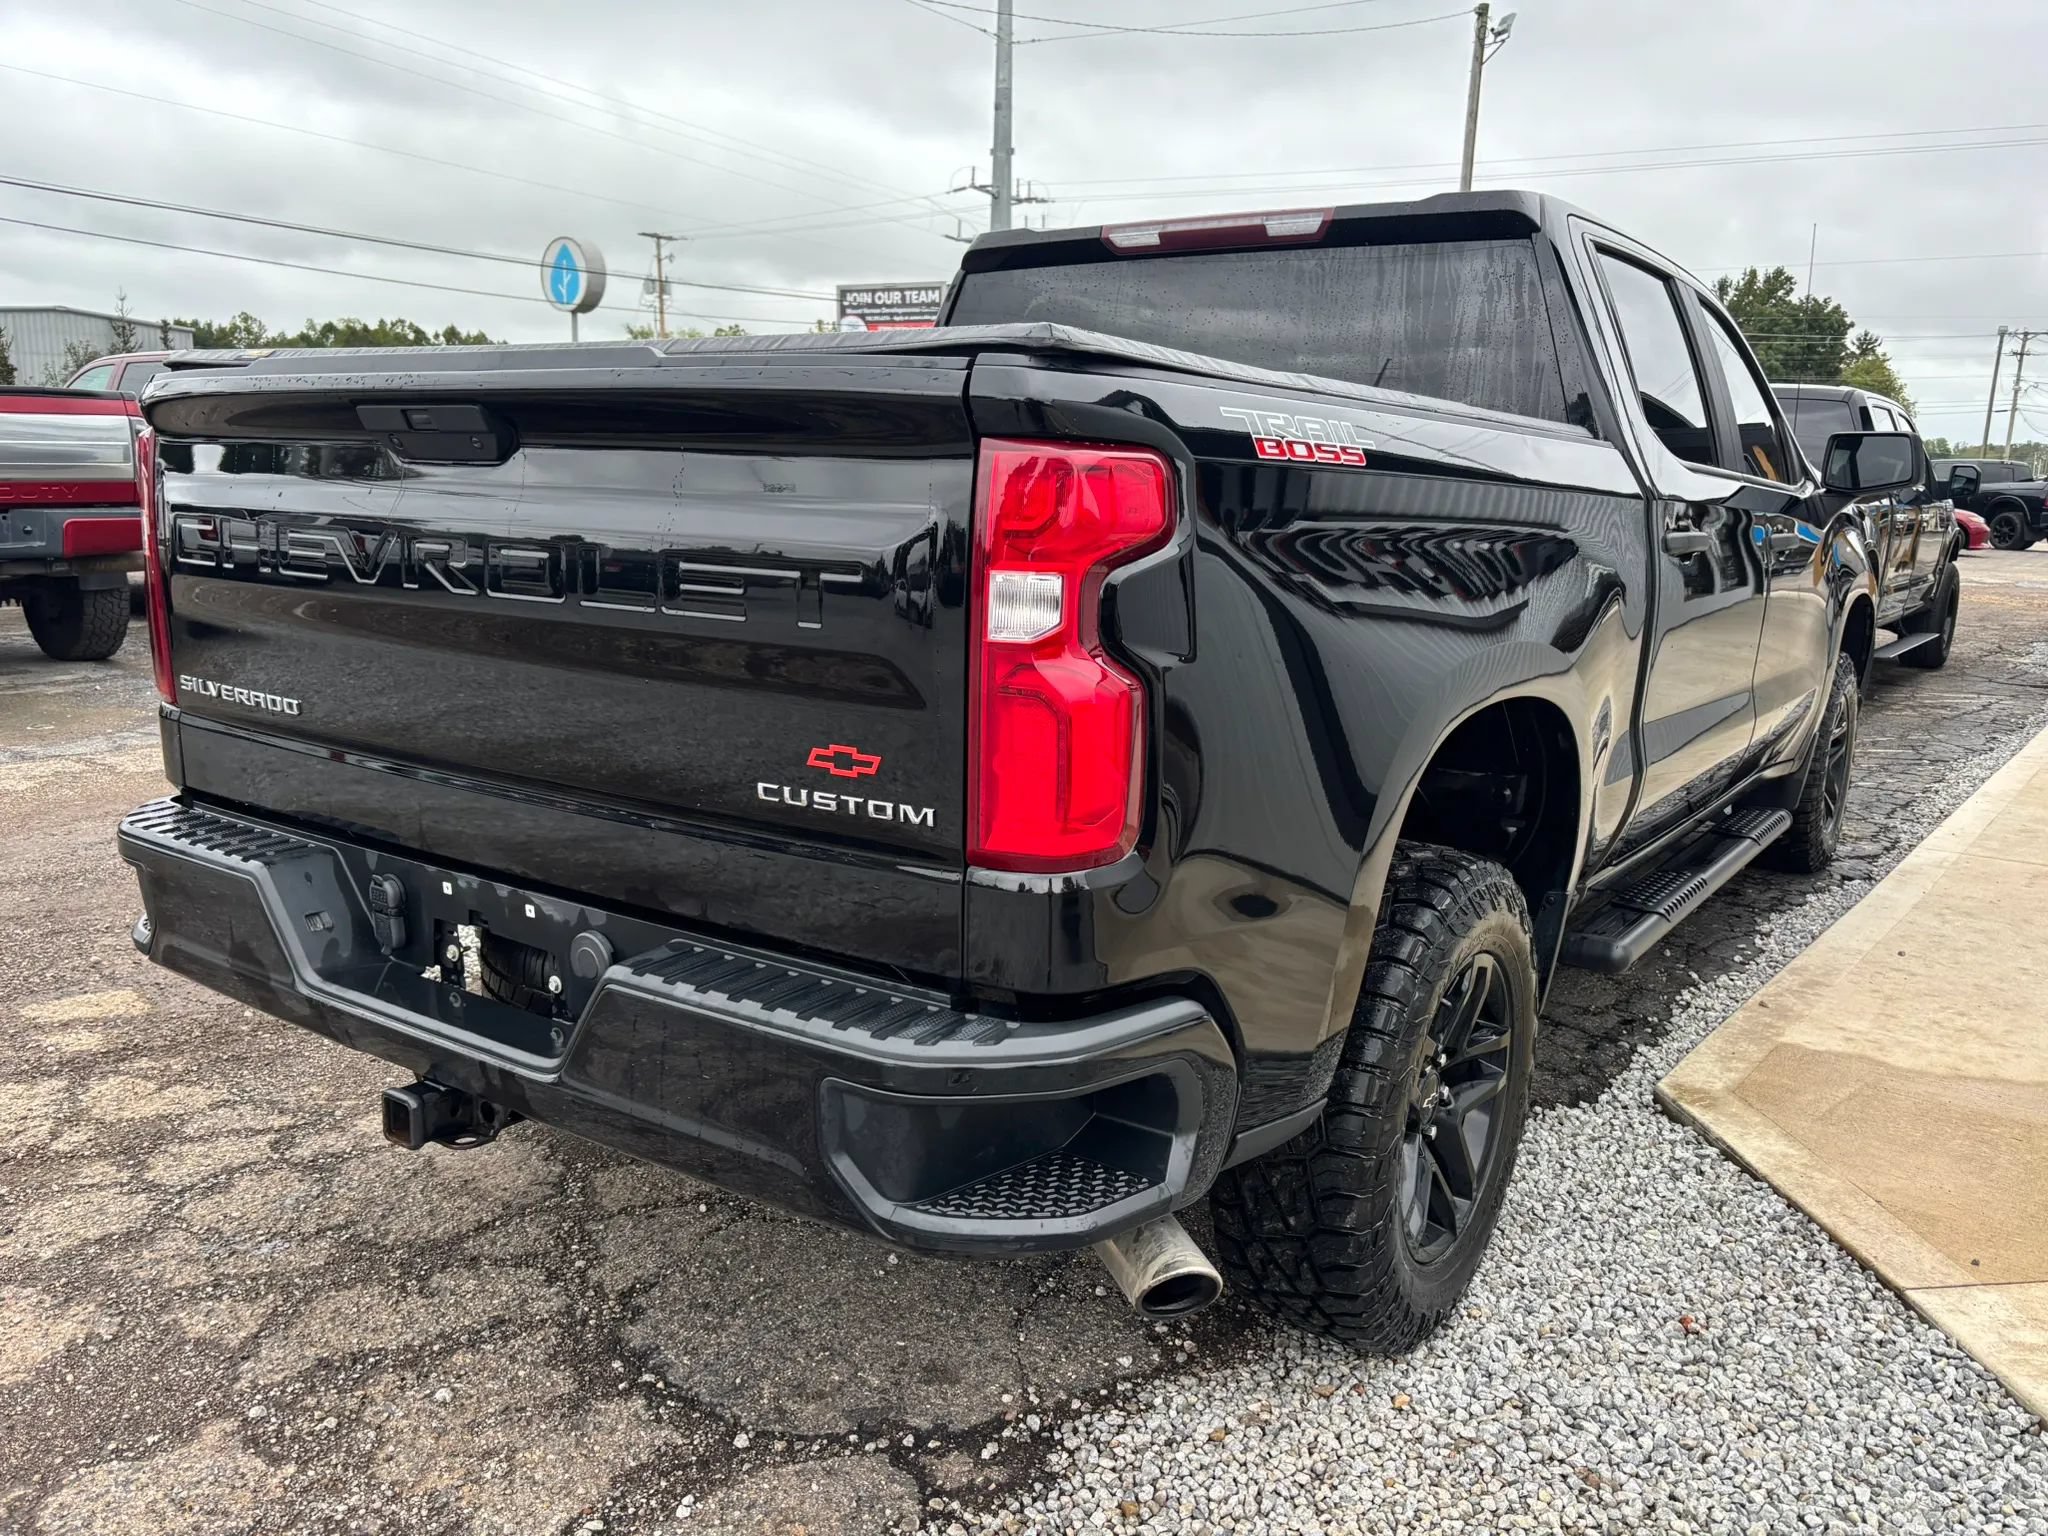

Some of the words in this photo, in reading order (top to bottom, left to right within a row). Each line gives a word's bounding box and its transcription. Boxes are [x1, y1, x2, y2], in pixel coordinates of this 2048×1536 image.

[843, 291, 872, 305] JOIN
[874, 290, 902, 305] OUR
[904, 289, 940, 304] TEAM
[1219, 406, 1377, 449] TRAIL
[1252, 435, 1367, 467] BOSS
[172, 508, 865, 630] CHEVROLET
[179, 674, 301, 716] SILVERADO
[756, 782, 936, 828] CUSTOM
